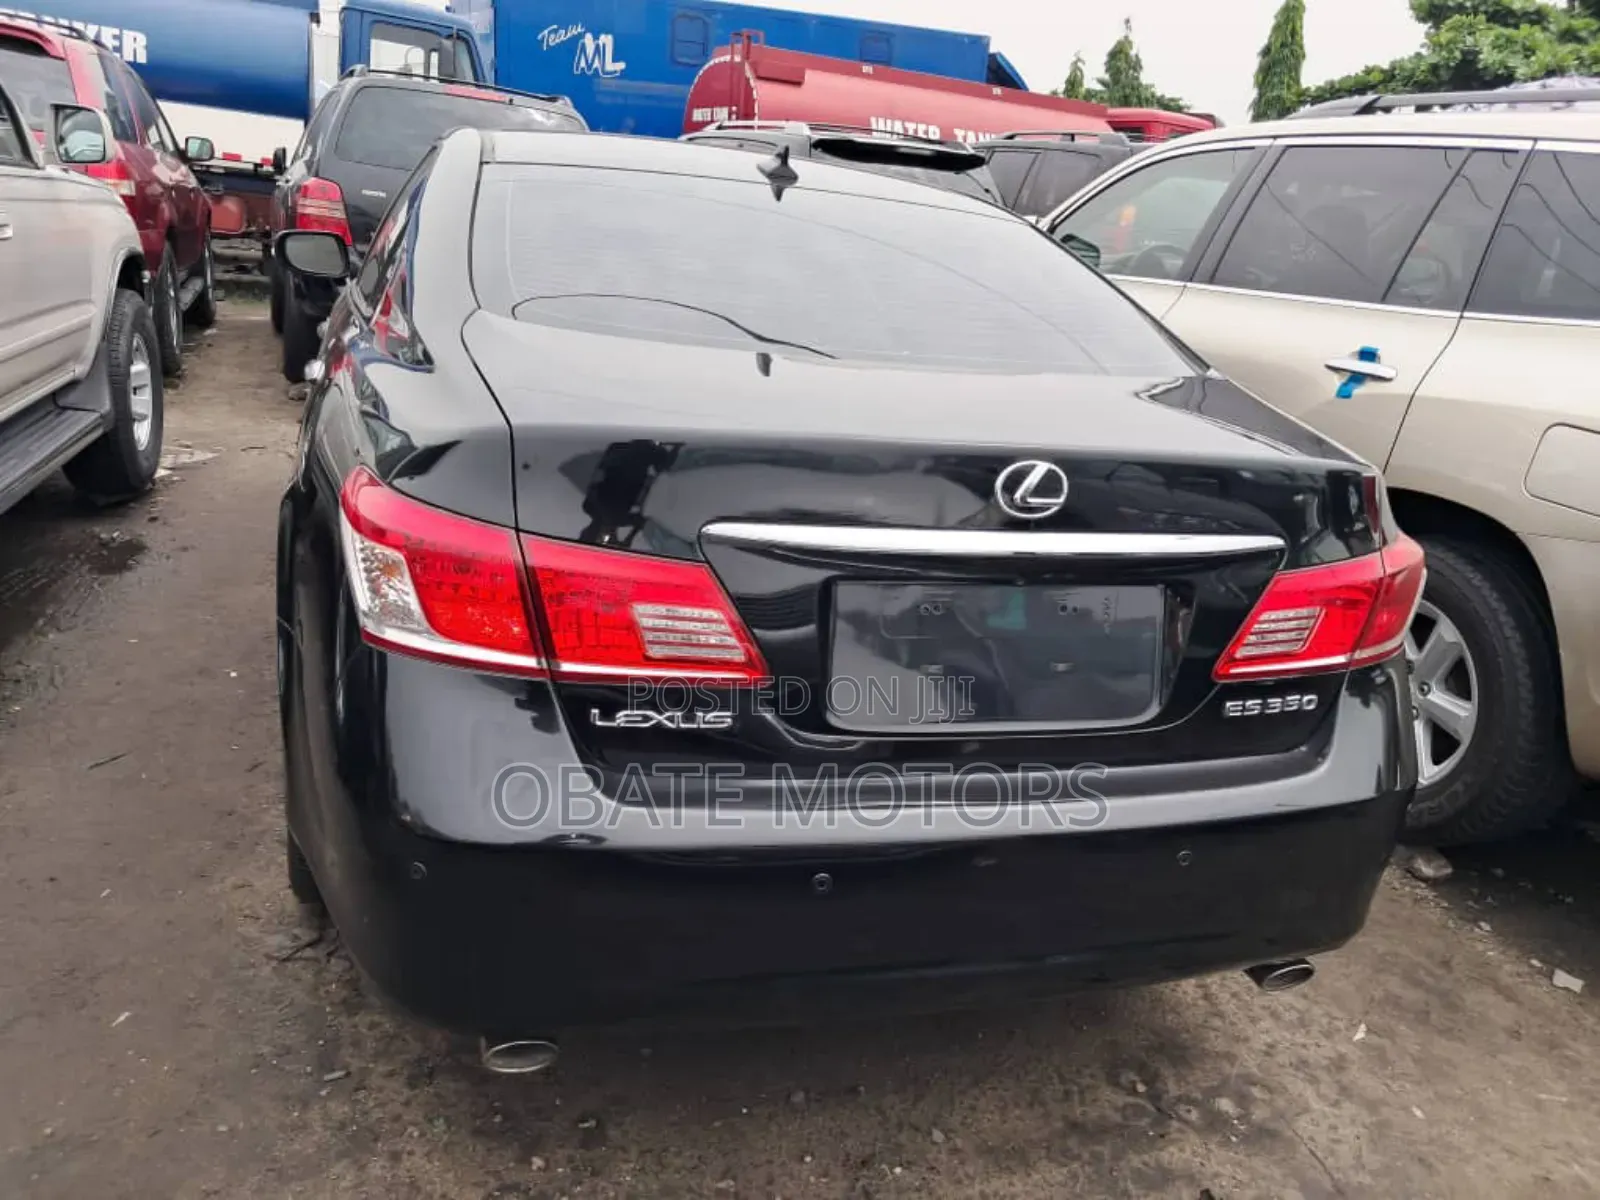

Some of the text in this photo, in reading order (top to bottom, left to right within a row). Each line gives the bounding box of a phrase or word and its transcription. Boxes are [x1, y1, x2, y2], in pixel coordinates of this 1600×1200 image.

[536, 22, 585, 51] Team
[573, 32, 626, 77] ML
[589, 708, 734, 729] LEXUS
